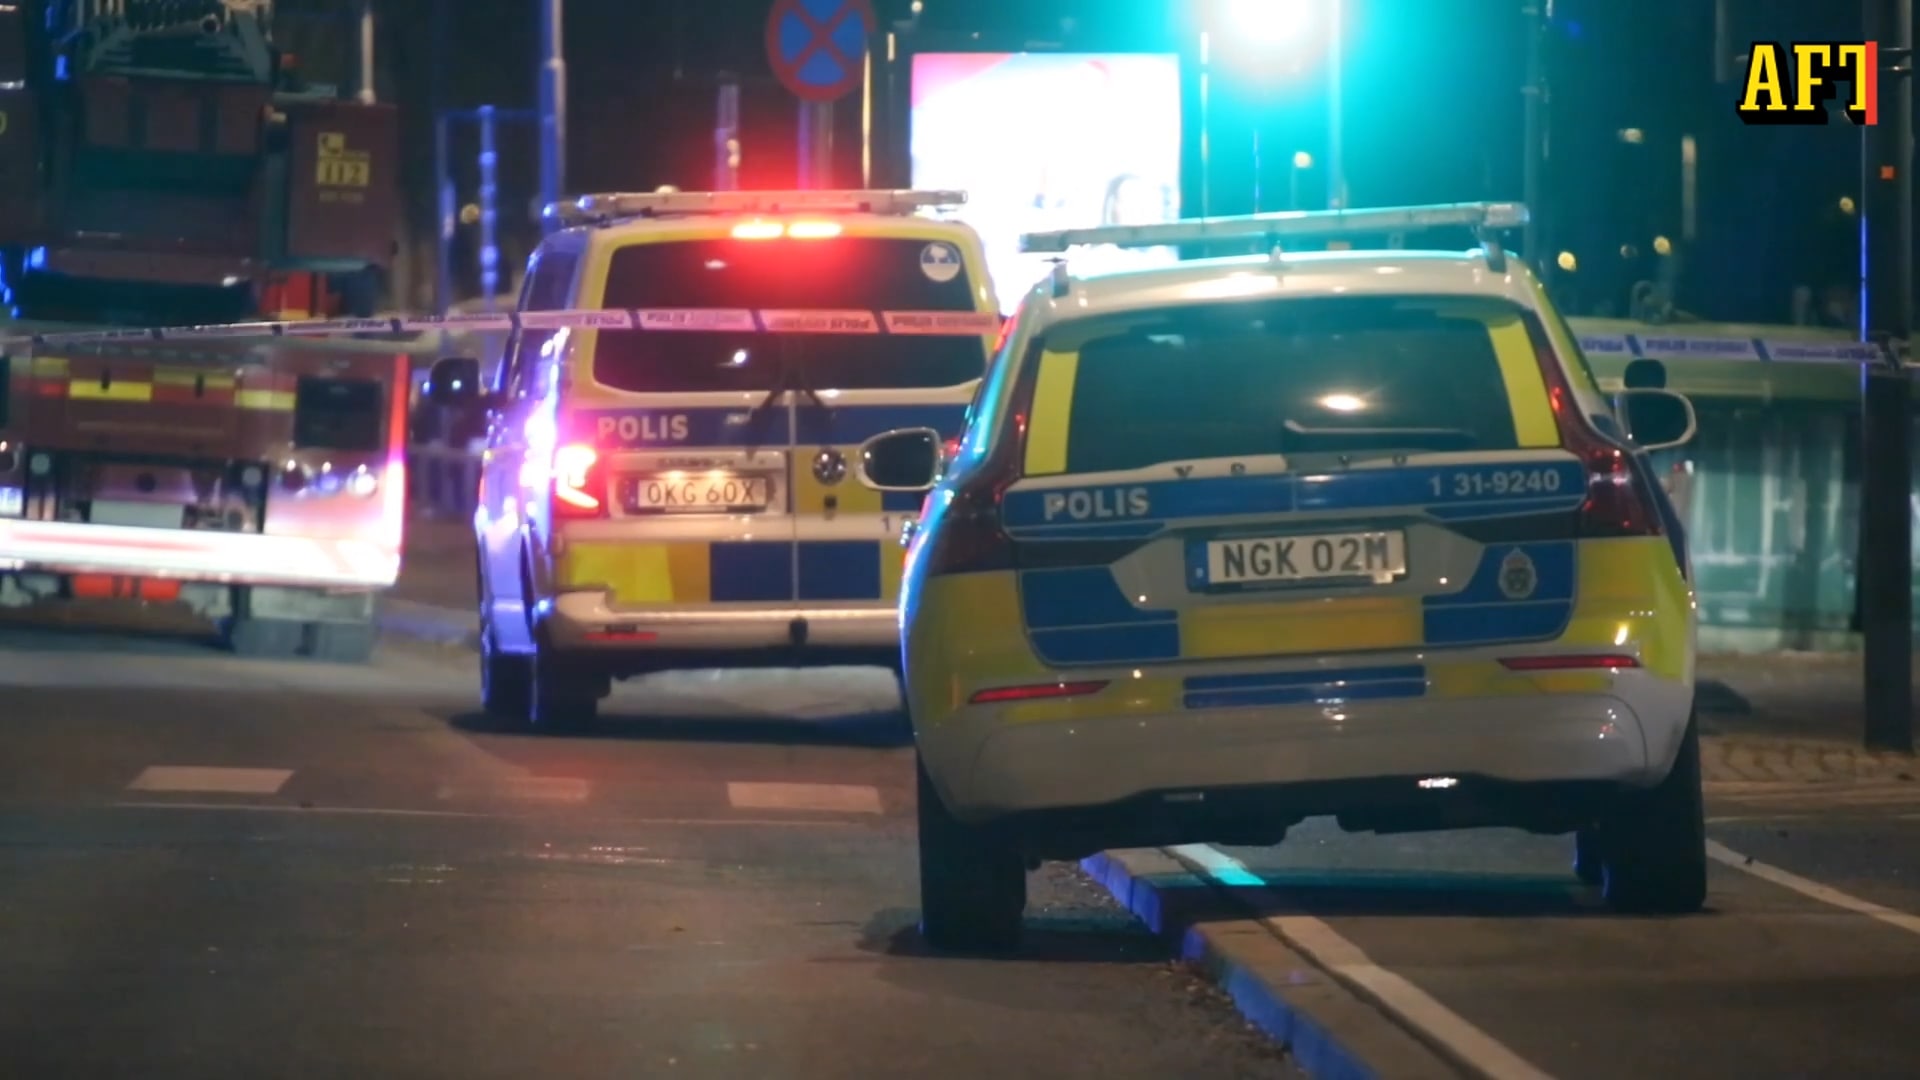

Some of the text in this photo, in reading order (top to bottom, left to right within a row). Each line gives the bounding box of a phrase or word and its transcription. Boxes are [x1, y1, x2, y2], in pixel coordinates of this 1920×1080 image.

[597, 414, 689, 441] POLIS
[647, 482, 755, 504] OKG 60X
[1430, 469, 1560, 496] 1 31-9240
[1042, 487, 1150, 521] POLIS
[1222, 537, 1389, 578] NGK 02M
